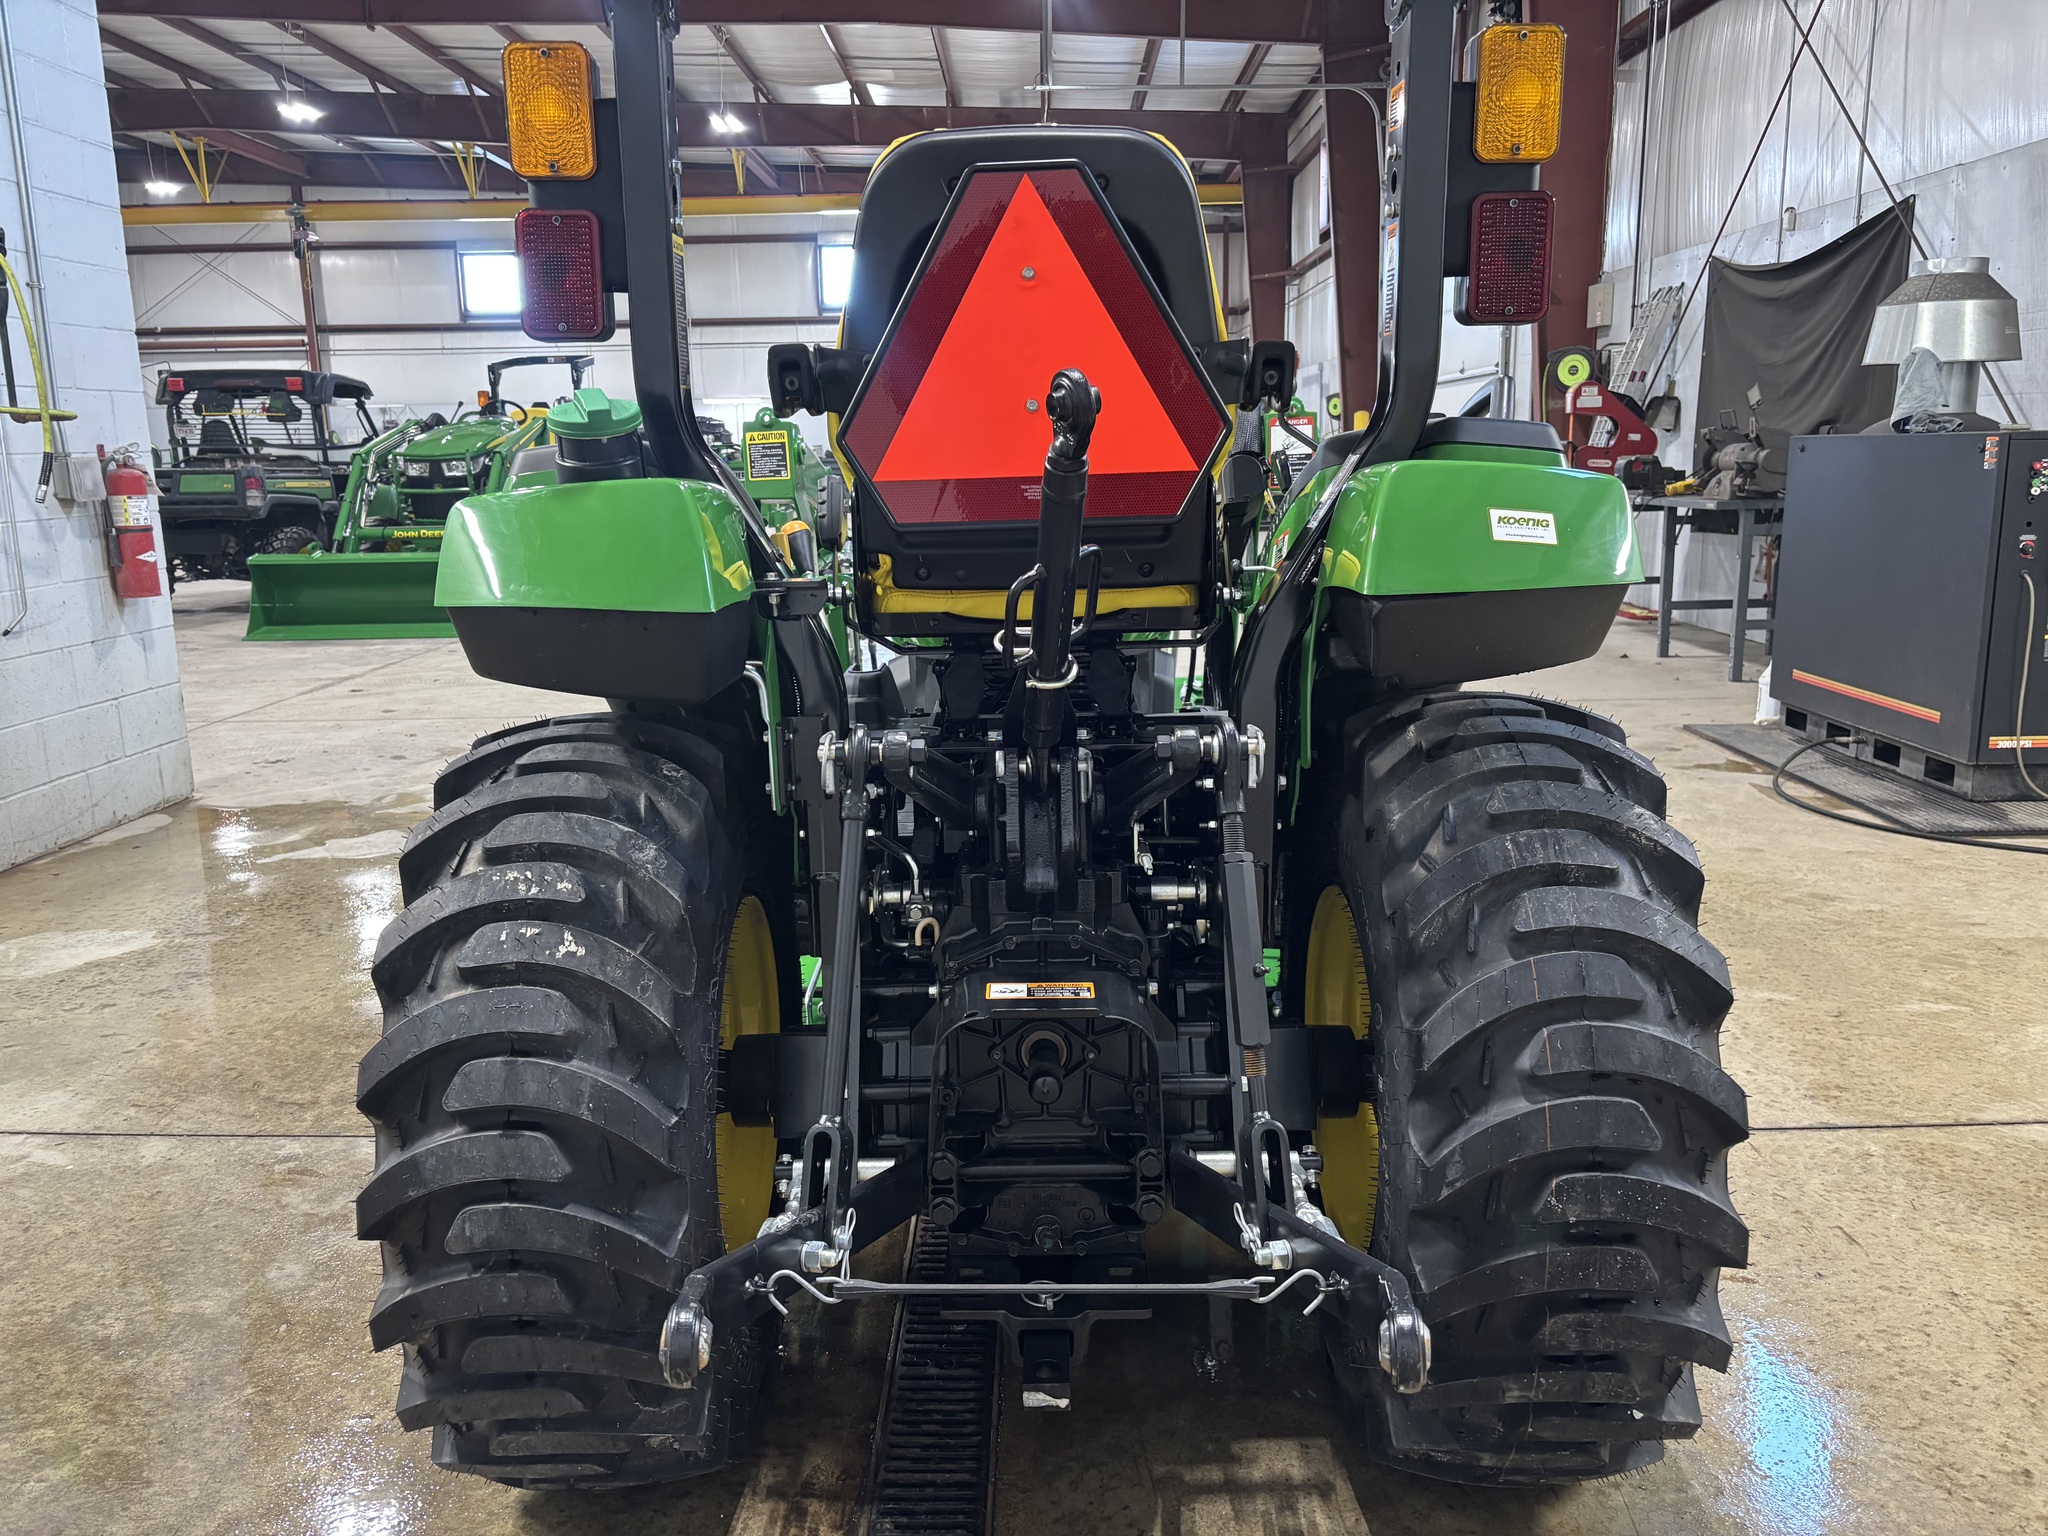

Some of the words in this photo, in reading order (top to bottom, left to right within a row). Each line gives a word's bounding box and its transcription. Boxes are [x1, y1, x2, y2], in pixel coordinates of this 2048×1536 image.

[757, 432, 785, 441] CAUTION
[391, 530, 418, 538] JOHN
[420, 529, 445, 538] DEE
[1996, 740, 2017, 749] 3000
[2019, 739, 2033, 748] PSI
